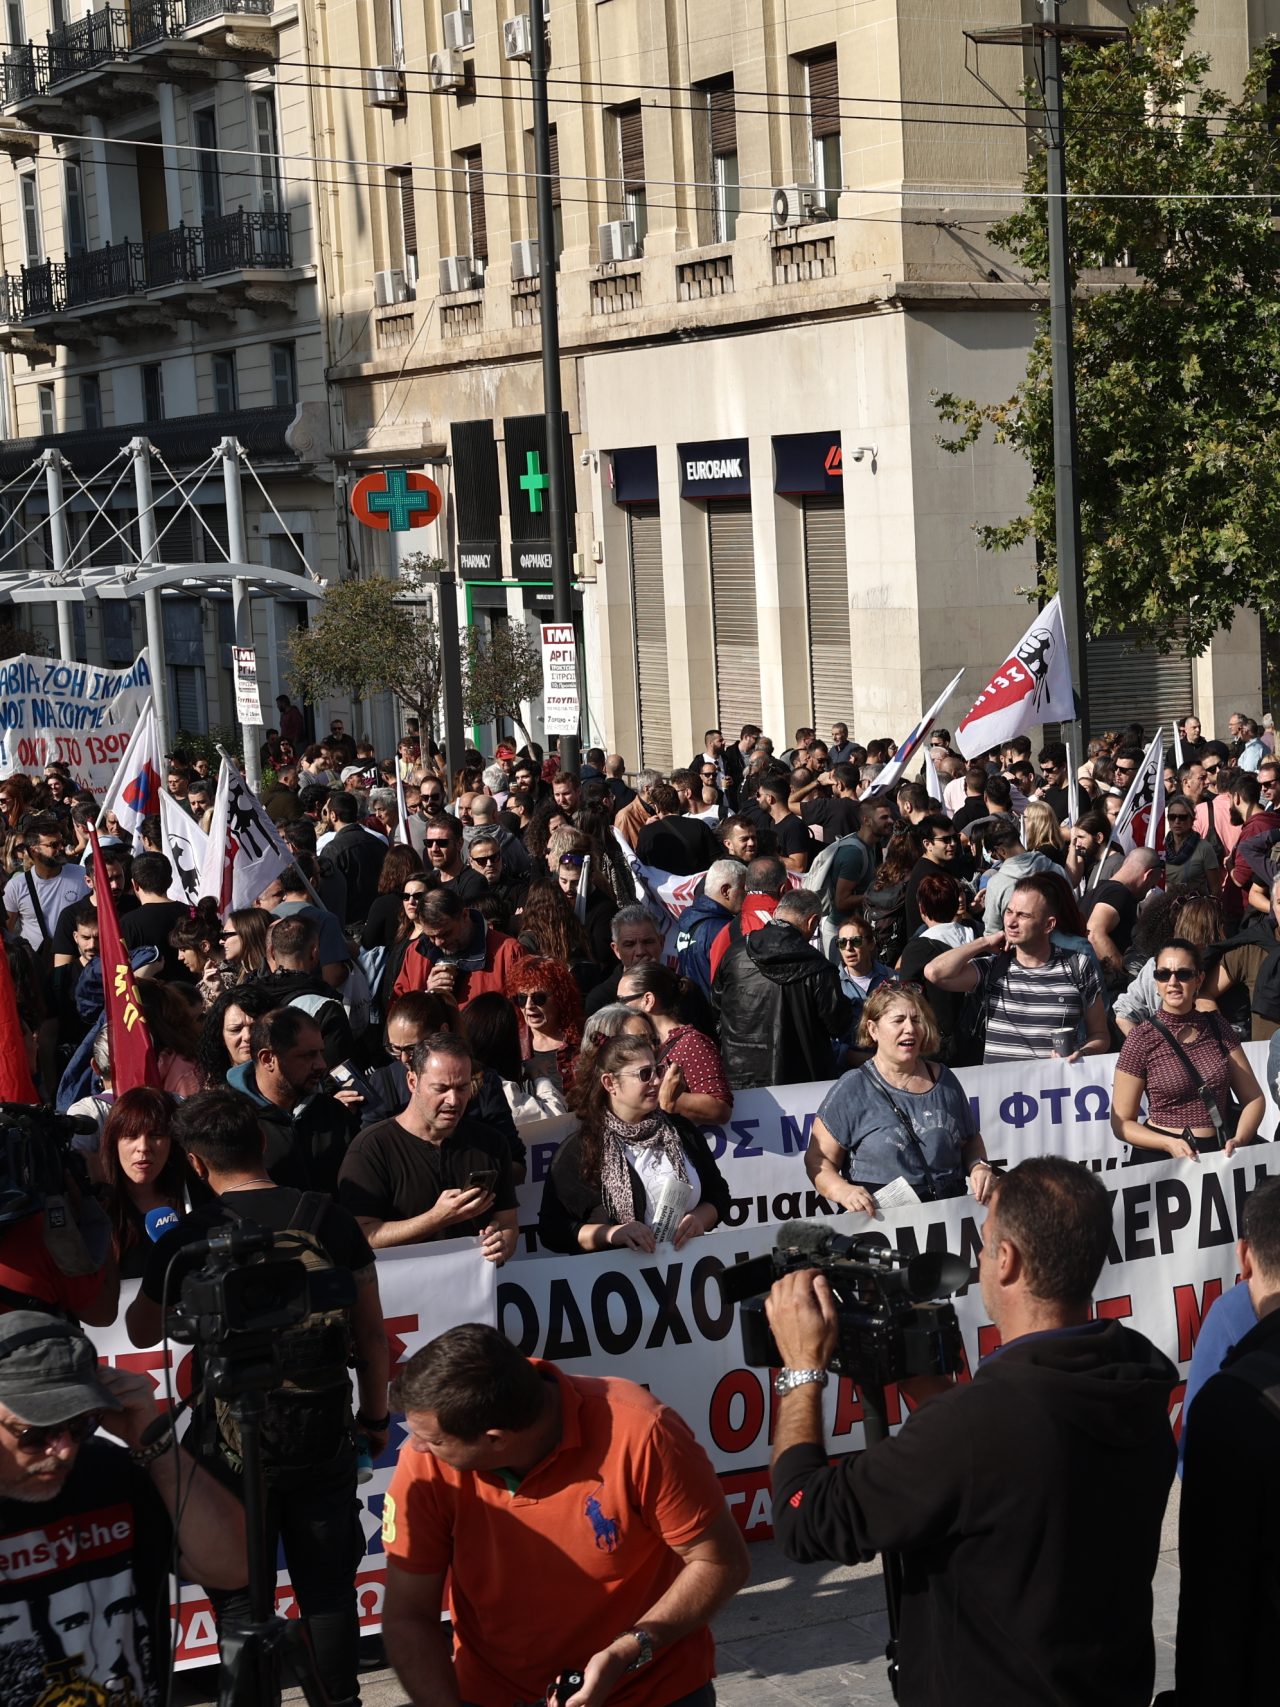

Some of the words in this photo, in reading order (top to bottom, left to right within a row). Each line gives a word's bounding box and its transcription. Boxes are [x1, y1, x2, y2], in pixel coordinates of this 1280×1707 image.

[686, 458, 743, 481] EUROBANK
[461, 554, 491, 568] PHARMACY
[999, 1085, 1148, 1128] ΦΤΩ
